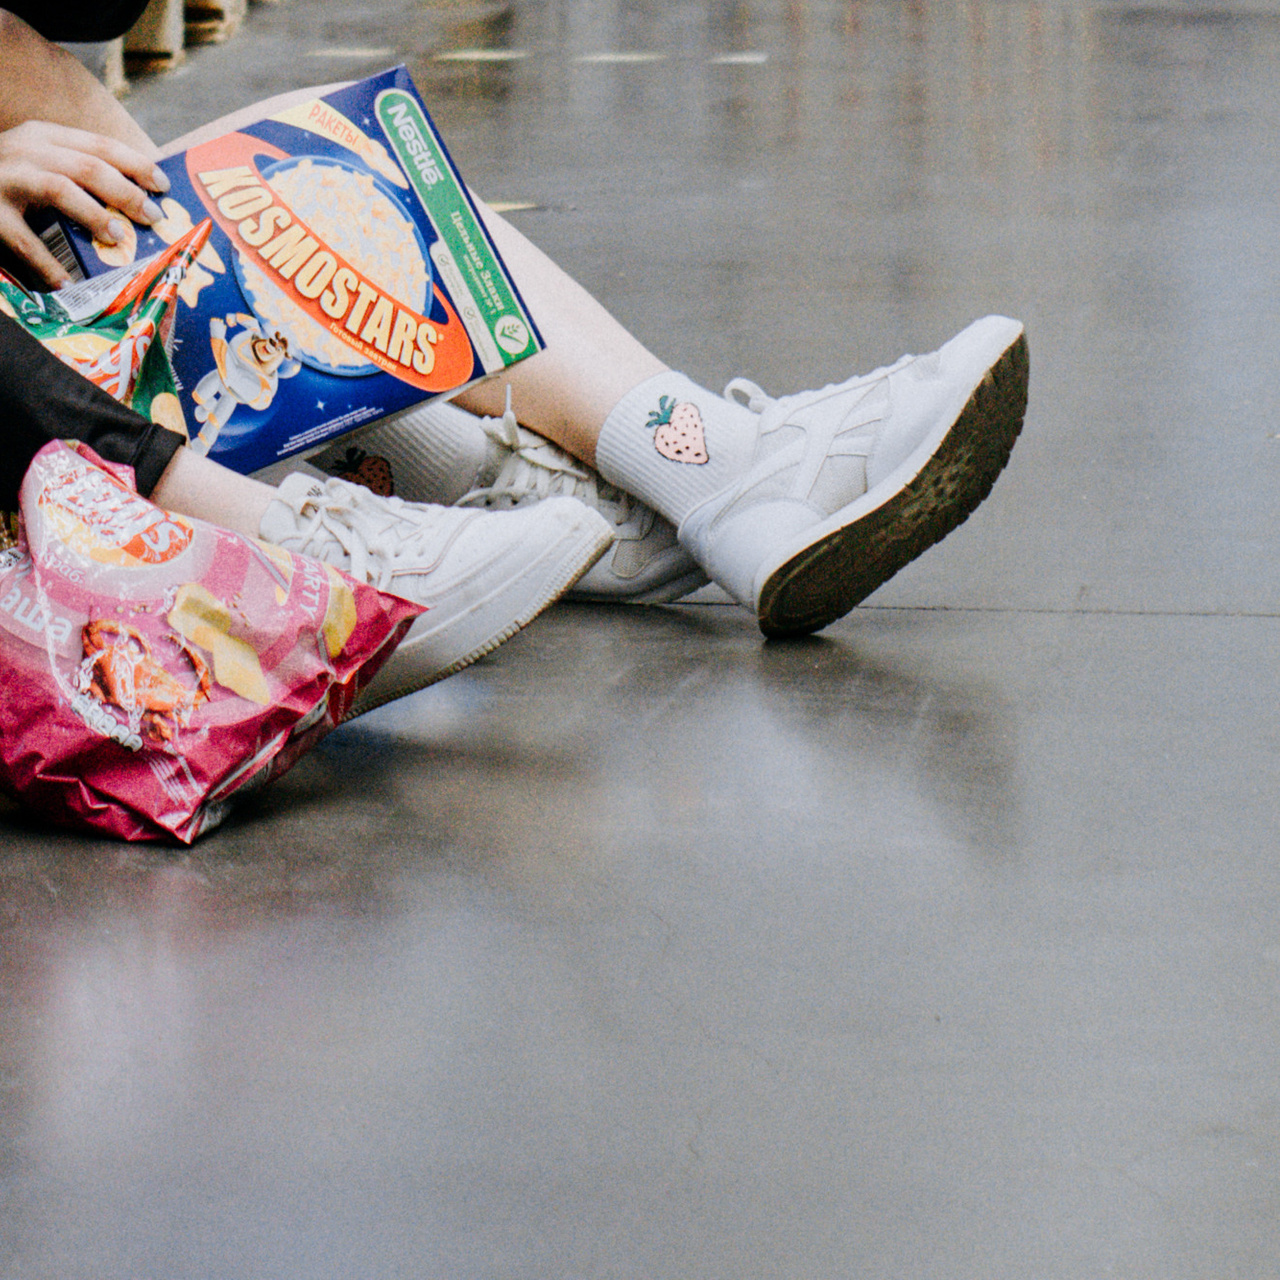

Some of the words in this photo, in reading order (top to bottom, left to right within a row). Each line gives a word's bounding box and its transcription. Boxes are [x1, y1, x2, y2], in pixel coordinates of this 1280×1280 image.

[307, 103, 360, 146] РАКЕТЫ
[198, 165, 439, 376] KOSMOSTARS
[329, 321, 364, 352] Готовый
[364, 346, 398, 373] завтрак
[299, 555, 322, 621] ARTY
